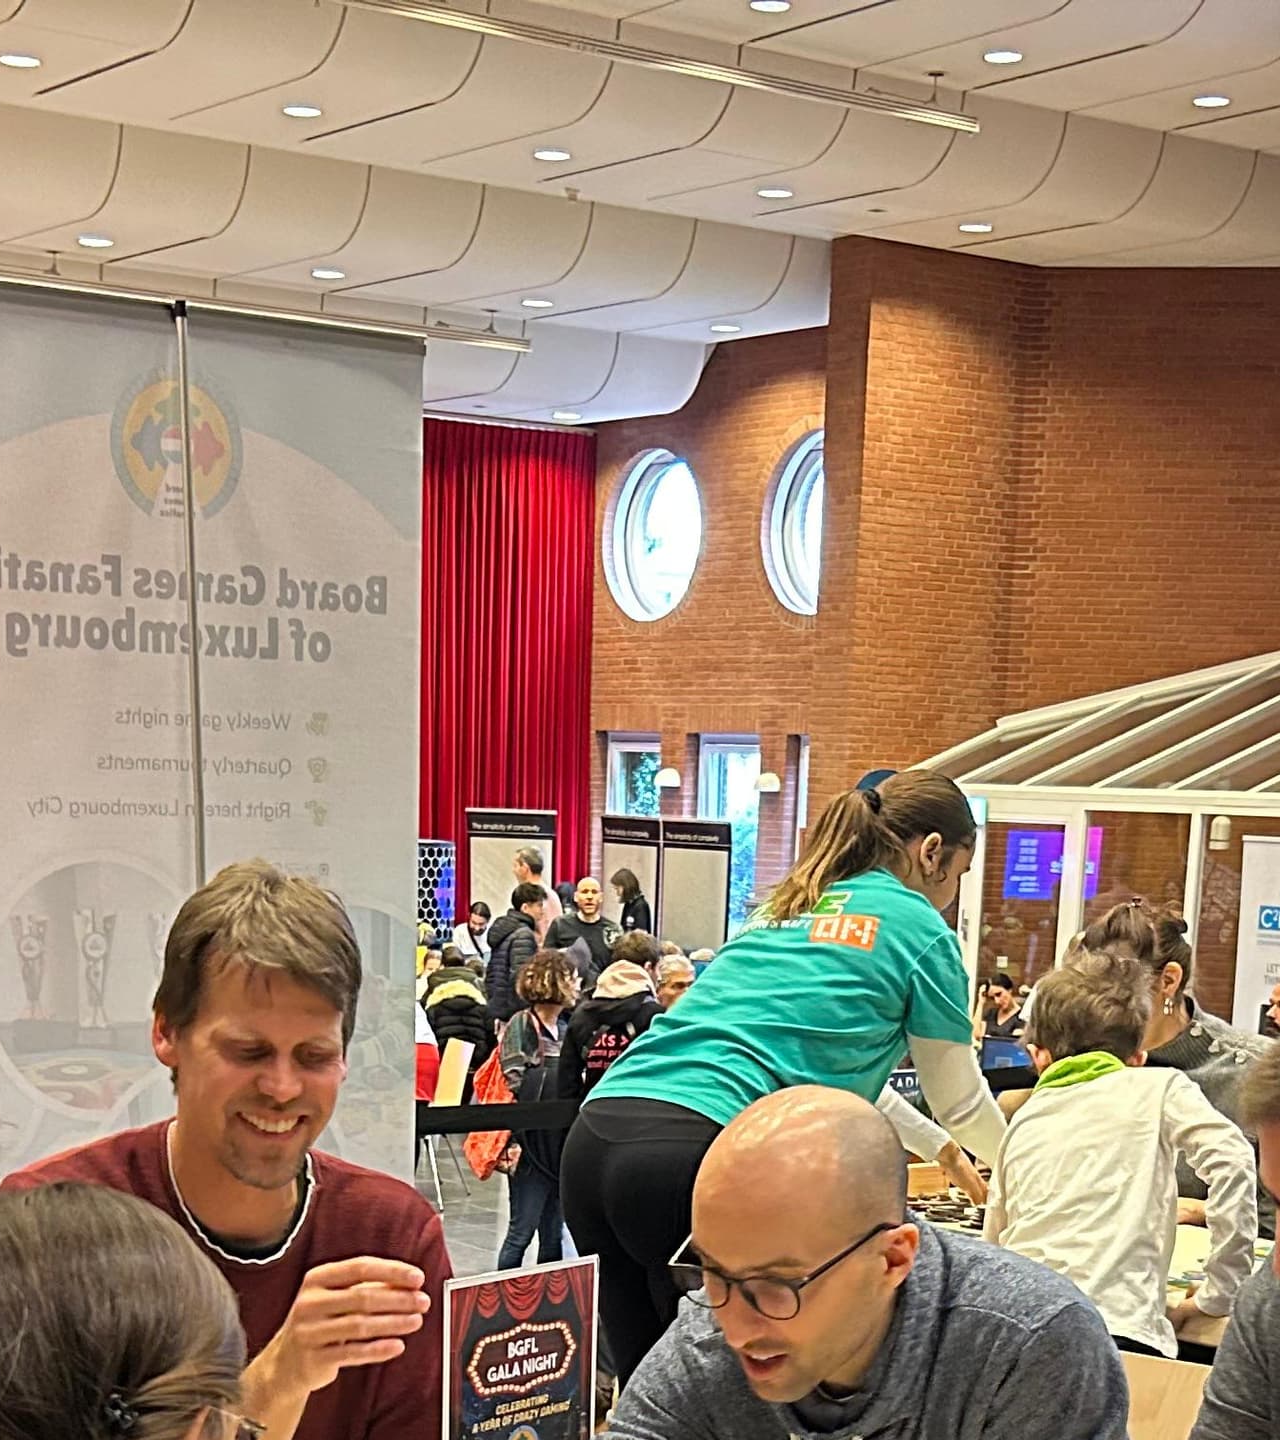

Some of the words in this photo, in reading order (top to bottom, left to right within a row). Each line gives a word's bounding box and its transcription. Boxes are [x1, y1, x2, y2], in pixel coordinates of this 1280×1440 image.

[507, 1336, 539, 1359] BGFL
[486, 1360, 521, 1383] GALA
[522, 1352, 558, 1376] NIGHT
[495, 1393, 550, 1415] CELEBRATING
[479, 1417, 501, 1432] YEAR
[501, 1413, 513, 1426] OF
